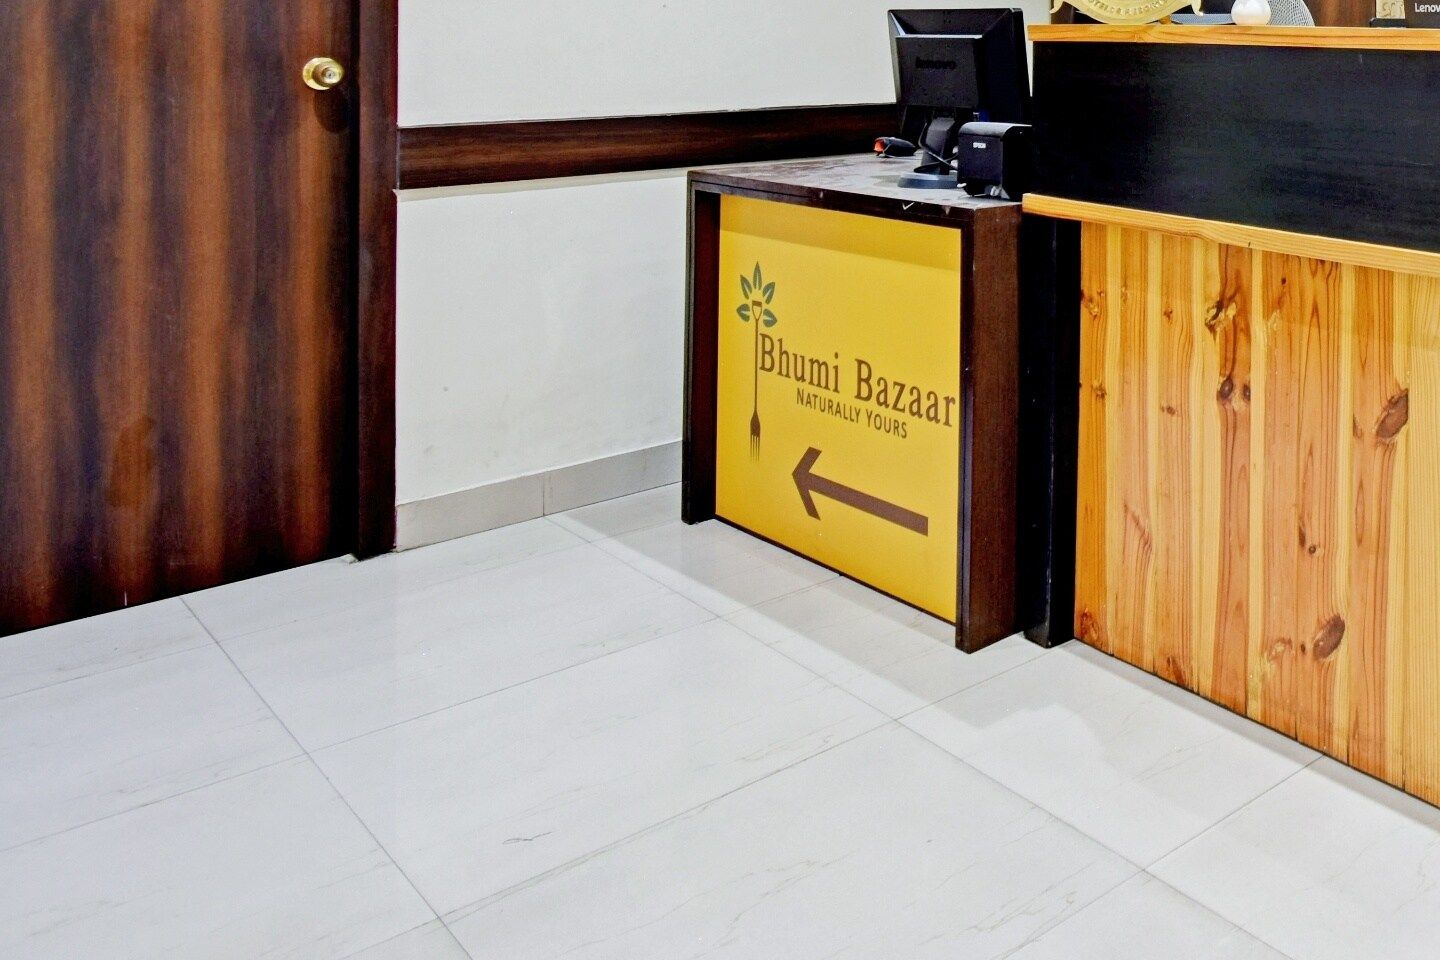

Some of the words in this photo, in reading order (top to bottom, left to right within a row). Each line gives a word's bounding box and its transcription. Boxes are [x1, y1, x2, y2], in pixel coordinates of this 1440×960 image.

[758, 332, 840, 394] Bhumi
[855, 358, 956, 428] Bazaar
[796, 387, 861, 424] NATURALLY
[866, 408, 907, 439] YOURS
